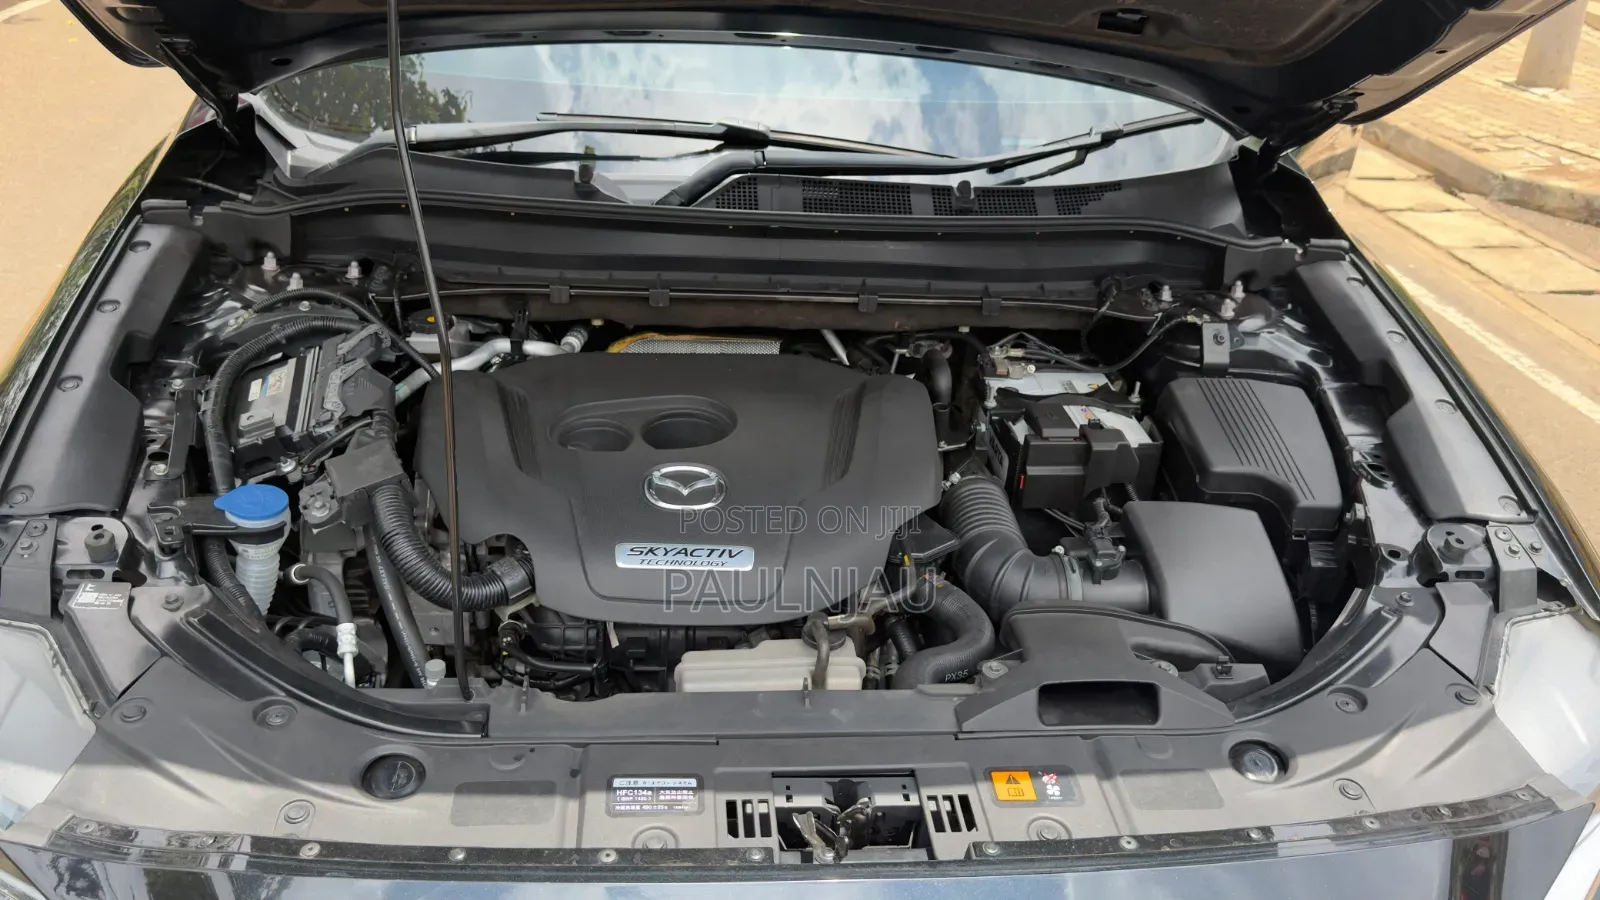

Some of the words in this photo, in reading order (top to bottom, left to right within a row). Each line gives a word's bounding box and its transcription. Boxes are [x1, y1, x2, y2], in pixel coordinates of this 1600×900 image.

[626, 546, 744, 559] SKYACTIV
[639, 558, 728, 567] TECHNOLOGY
[945, 669, 969, 682] PX35
